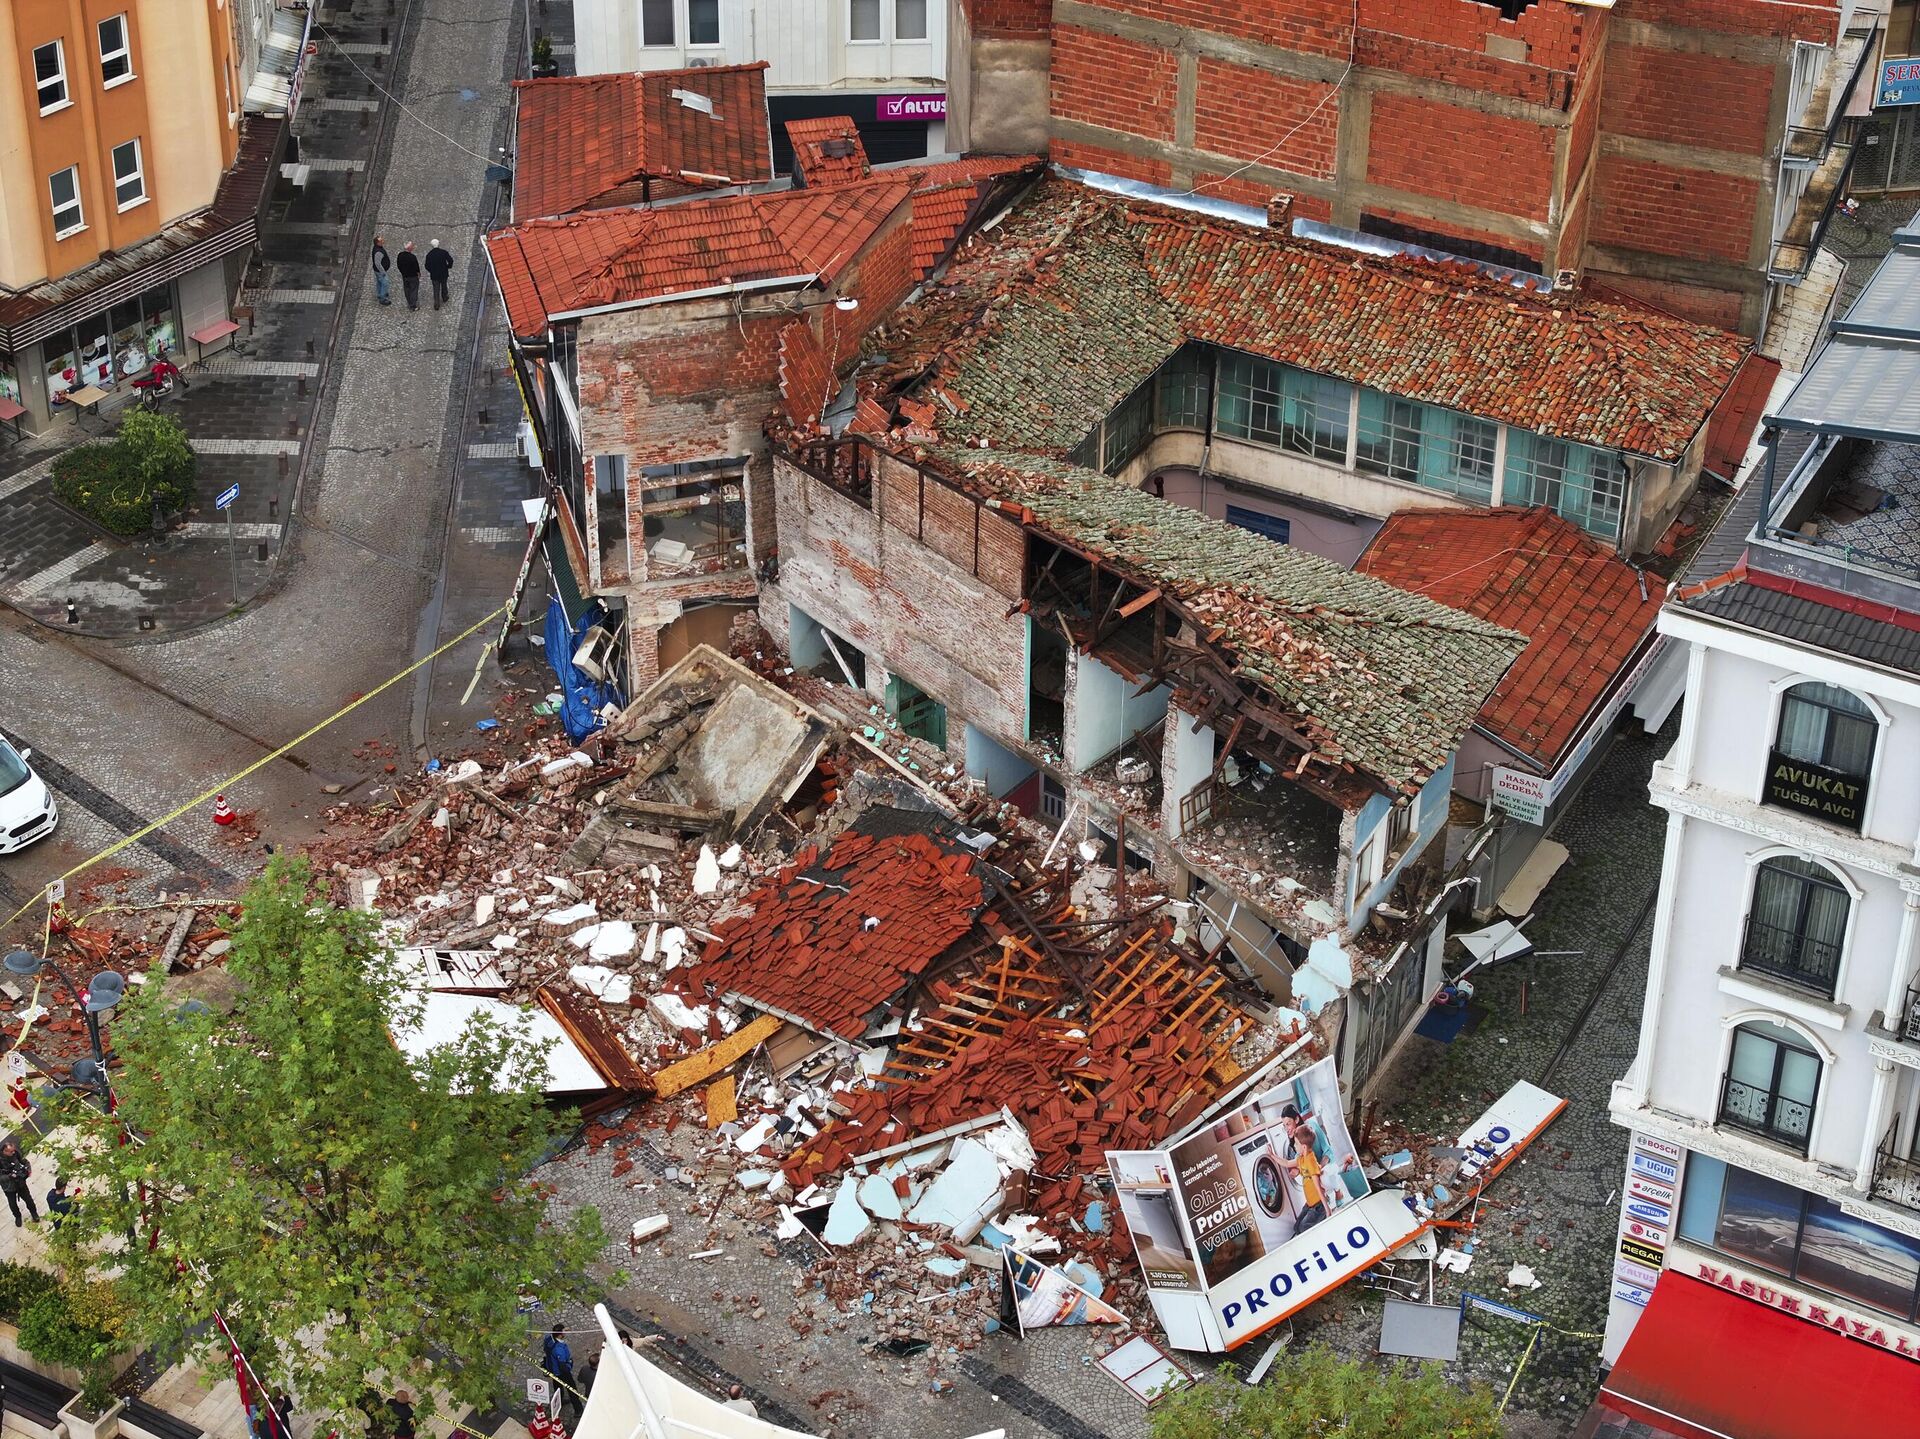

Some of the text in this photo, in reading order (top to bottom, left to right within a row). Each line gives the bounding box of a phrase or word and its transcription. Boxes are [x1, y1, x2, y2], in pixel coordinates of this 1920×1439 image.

[1505, 774, 1539, 789] HASAN
[1774, 765, 1859, 800] AVUKAT
[1496, 792, 1510, 801] HAC
[1773, 786, 1856, 820] TUĞBA AVCI
[1647, 1140, 1677, 1156] BOSCH
[1190, 1177, 1237, 1213] Oh be
[1641, 1185, 1672, 1200] arçelik
[1195, 1196, 1248, 1235] Profilo
[1202, 1213, 1257, 1252] varmış
[1645, 1230, 1660, 1240] LG
[1622, 1244, 1661, 1263] REGAL
[1699, 1264, 1800, 1315] NASUH
[1809, 1304, 1888, 1346] KAYA
